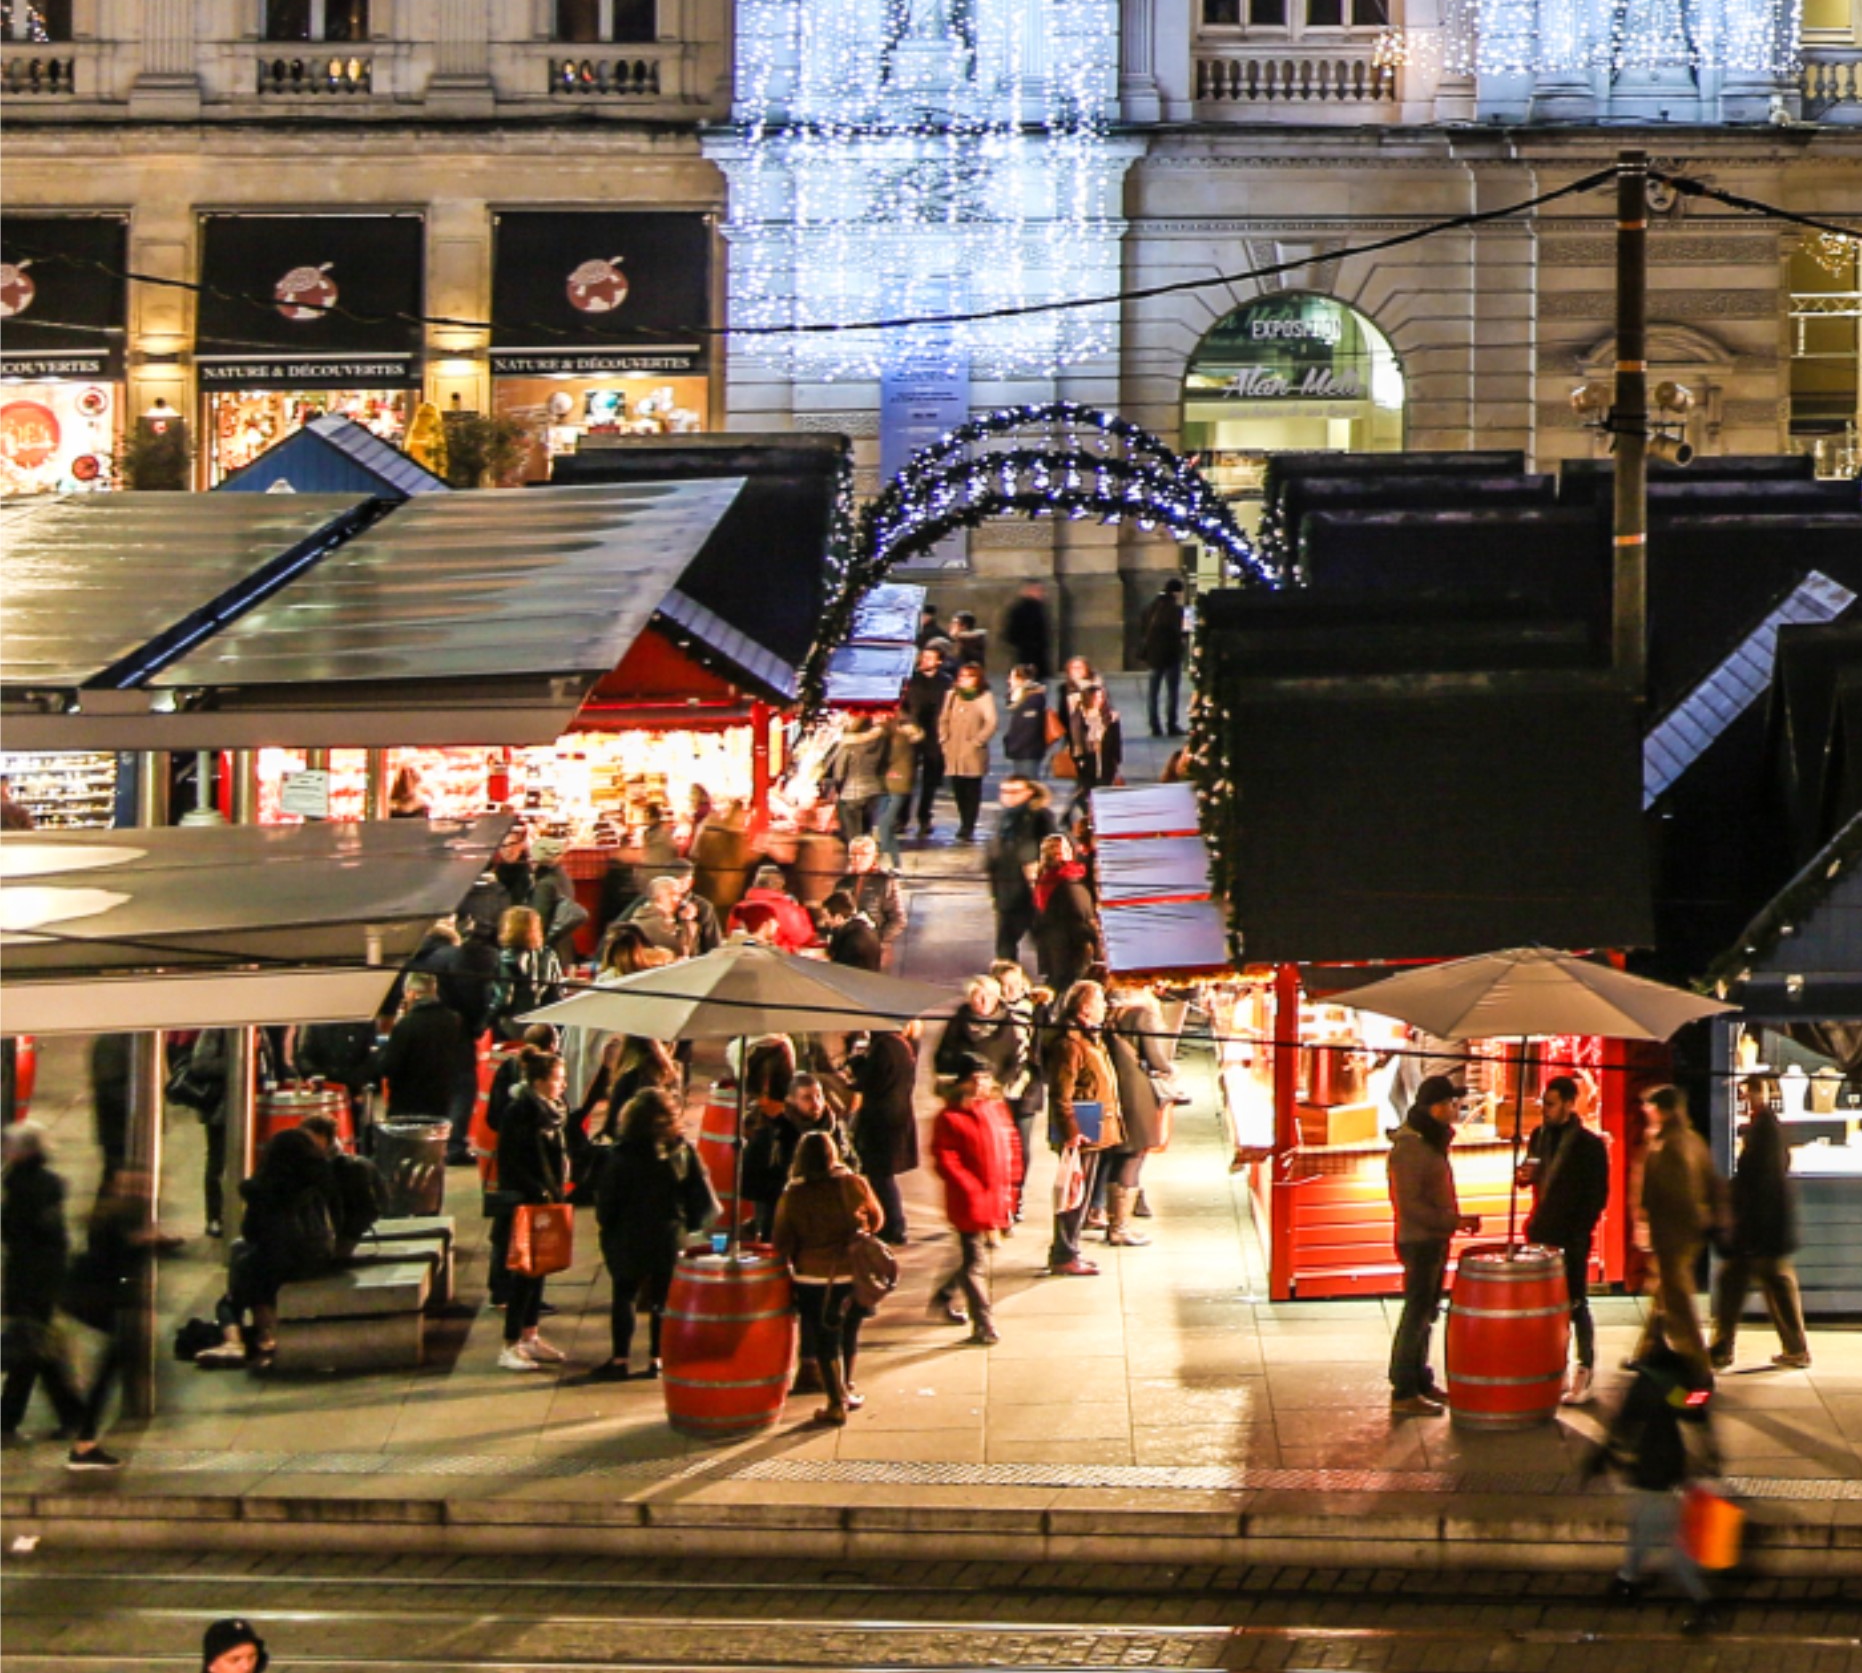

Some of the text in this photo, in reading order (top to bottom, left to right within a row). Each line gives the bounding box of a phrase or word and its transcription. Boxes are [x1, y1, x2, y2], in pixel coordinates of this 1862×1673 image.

[1251, 319, 1341, 340] EXPOSITION
[203, 362, 405, 379] NATURE & DÉCOUVERTES
[494, 355, 691, 371] NATURE & DÉCOUVERTES
